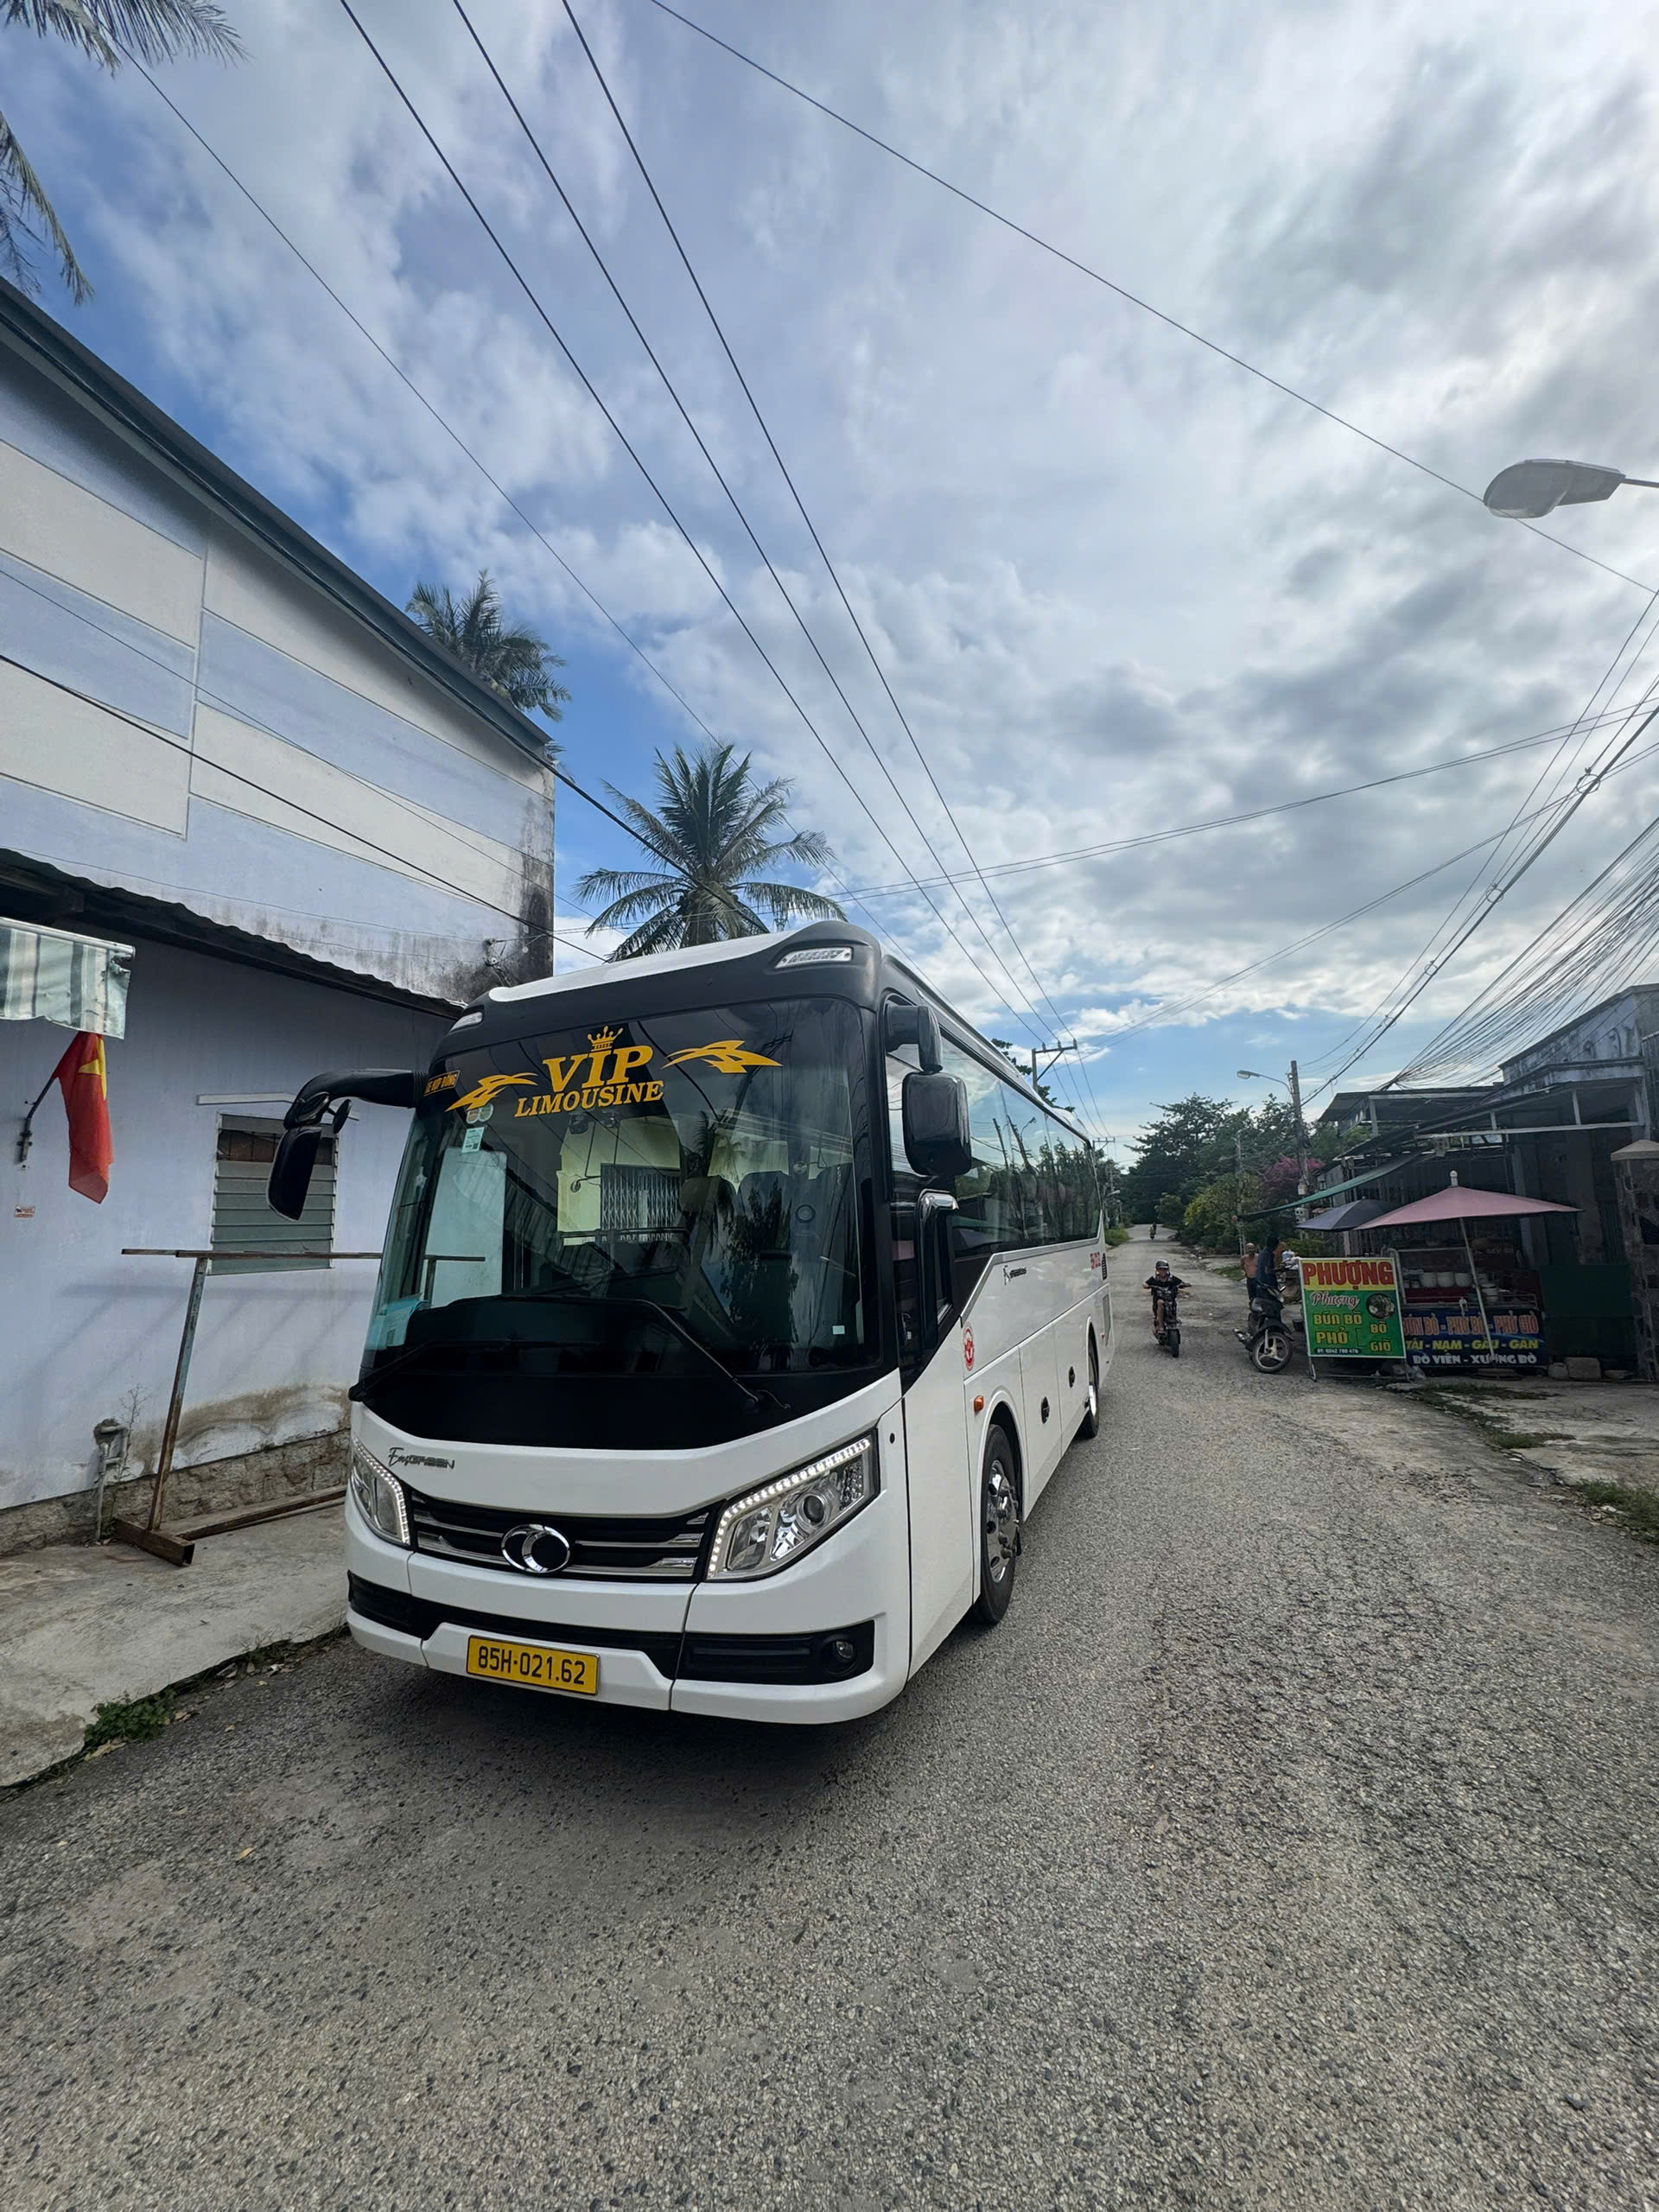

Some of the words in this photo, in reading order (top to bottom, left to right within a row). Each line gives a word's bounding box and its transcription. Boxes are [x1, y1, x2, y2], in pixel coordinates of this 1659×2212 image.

[542, 1045, 654, 1093] VIP
[514, 1080, 664, 1117] LIMOUSINE
[1301, 1260, 1395, 1290] PHƯỢNG
[478, 1645, 585, 1686] 85H-021.62
